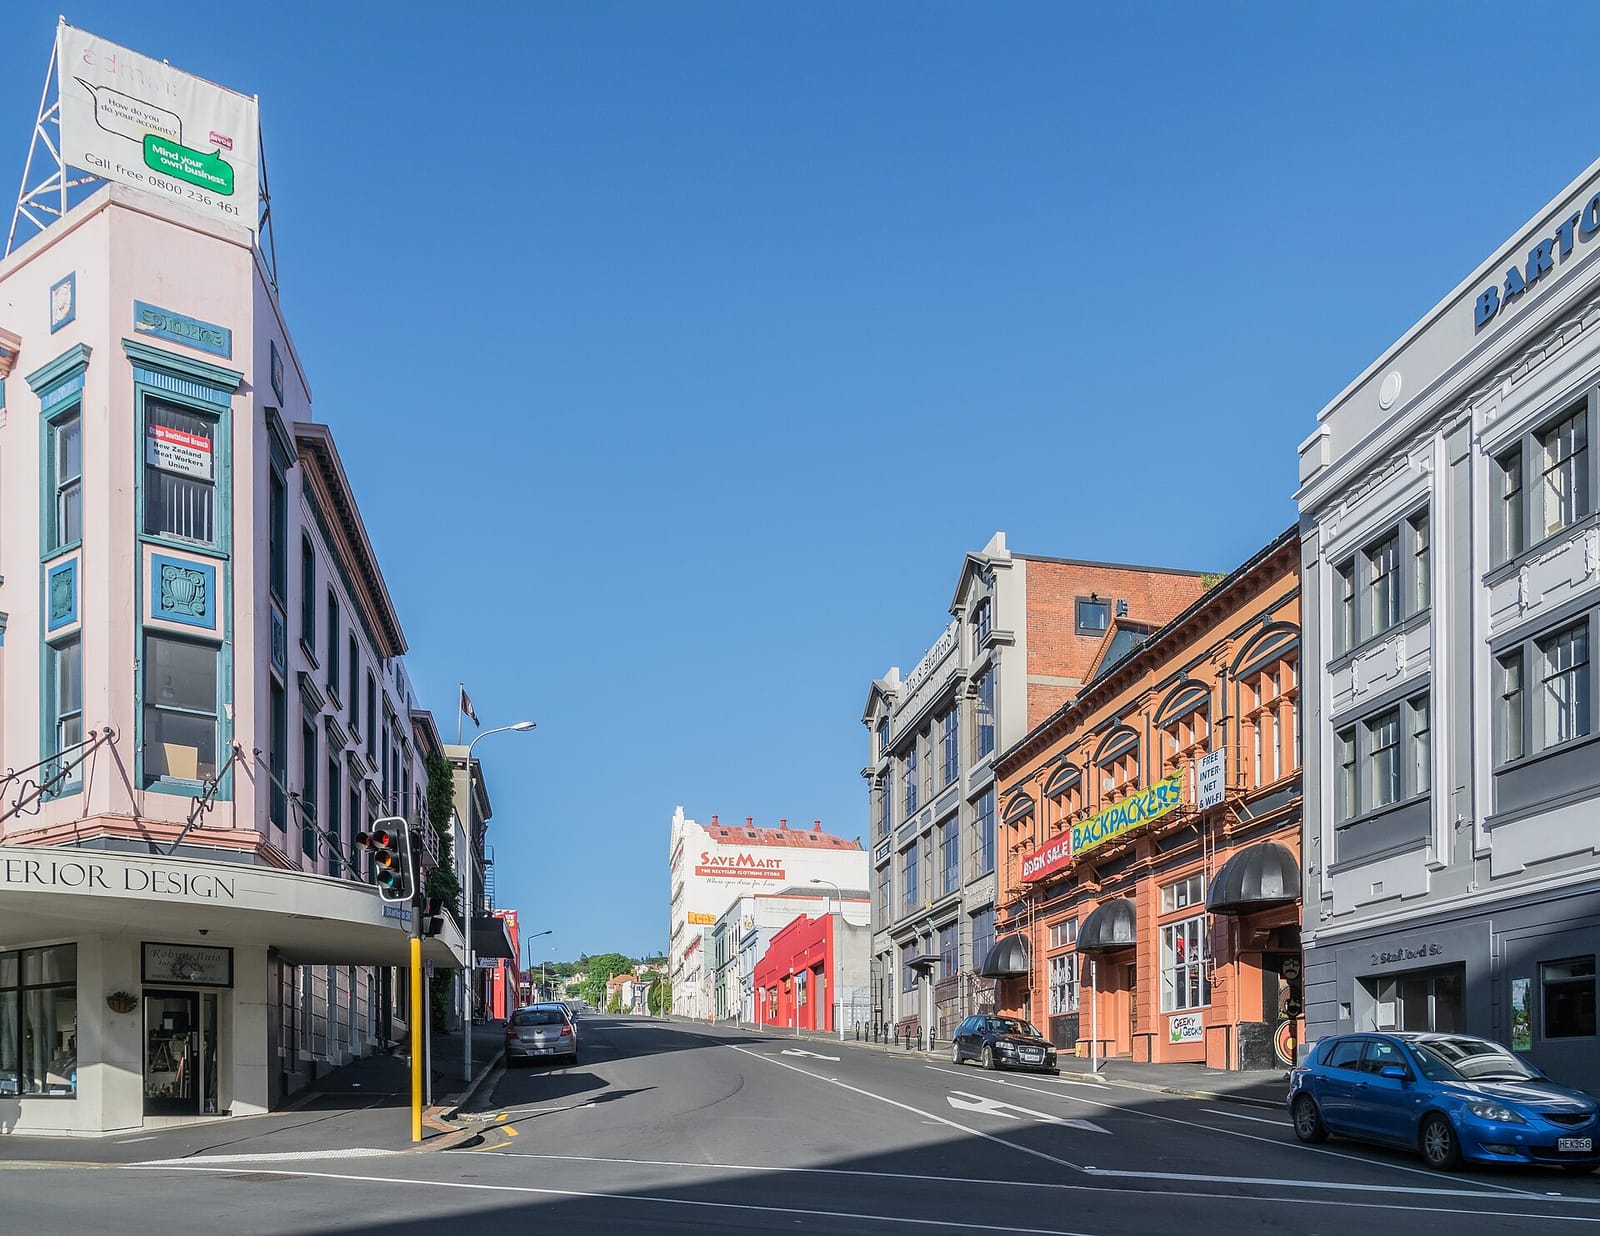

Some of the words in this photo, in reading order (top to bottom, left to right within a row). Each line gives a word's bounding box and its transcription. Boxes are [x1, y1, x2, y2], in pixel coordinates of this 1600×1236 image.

[101, 104, 113, 113] do
[114, 109, 133, 121] your
[136, 118, 177, 137] accounts?
[108, 98, 129, 111] How
[130, 107, 142, 116] do
[144, 113, 160, 123] you
[152, 143, 179, 161] Mind
[180, 156, 203, 168] your
[160, 157, 183, 171] own
[185, 164, 227, 186] business.
[85, 152, 111, 170] Call
[116, 163, 144, 182] free
[148, 176, 182, 195] 0800
[187, 189, 212, 206] 236
[216, 201, 240, 216] 461
[153, 441, 170, 449] New
[172, 446, 202, 459] Zealand
[153, 449, 172, 459] Meat
[174, 454, 204, 467] Workers
[168, 460, 190, 471] Union
[1202, 752, 1219, 767] FREE
[1199, 765, 1221, 782] INTER-
[1203, 780, 1217, 793] NET
[1205, 791, 1222, 806] WI-FI
[1072, 778, 1181, 851] BACKPACKERS
[1047, 840, 1068, 865] SALE
[0, 858, 112, 889] ERIOR
[123, 868, 236, 899] DESIGN
[1370, 953, 1379, 966] 2
[1380, 944, 1427, 964] Stafford
[1429, 943, 1443, 956] St
[1174, 1017, 1196, 1029] GEEKY
